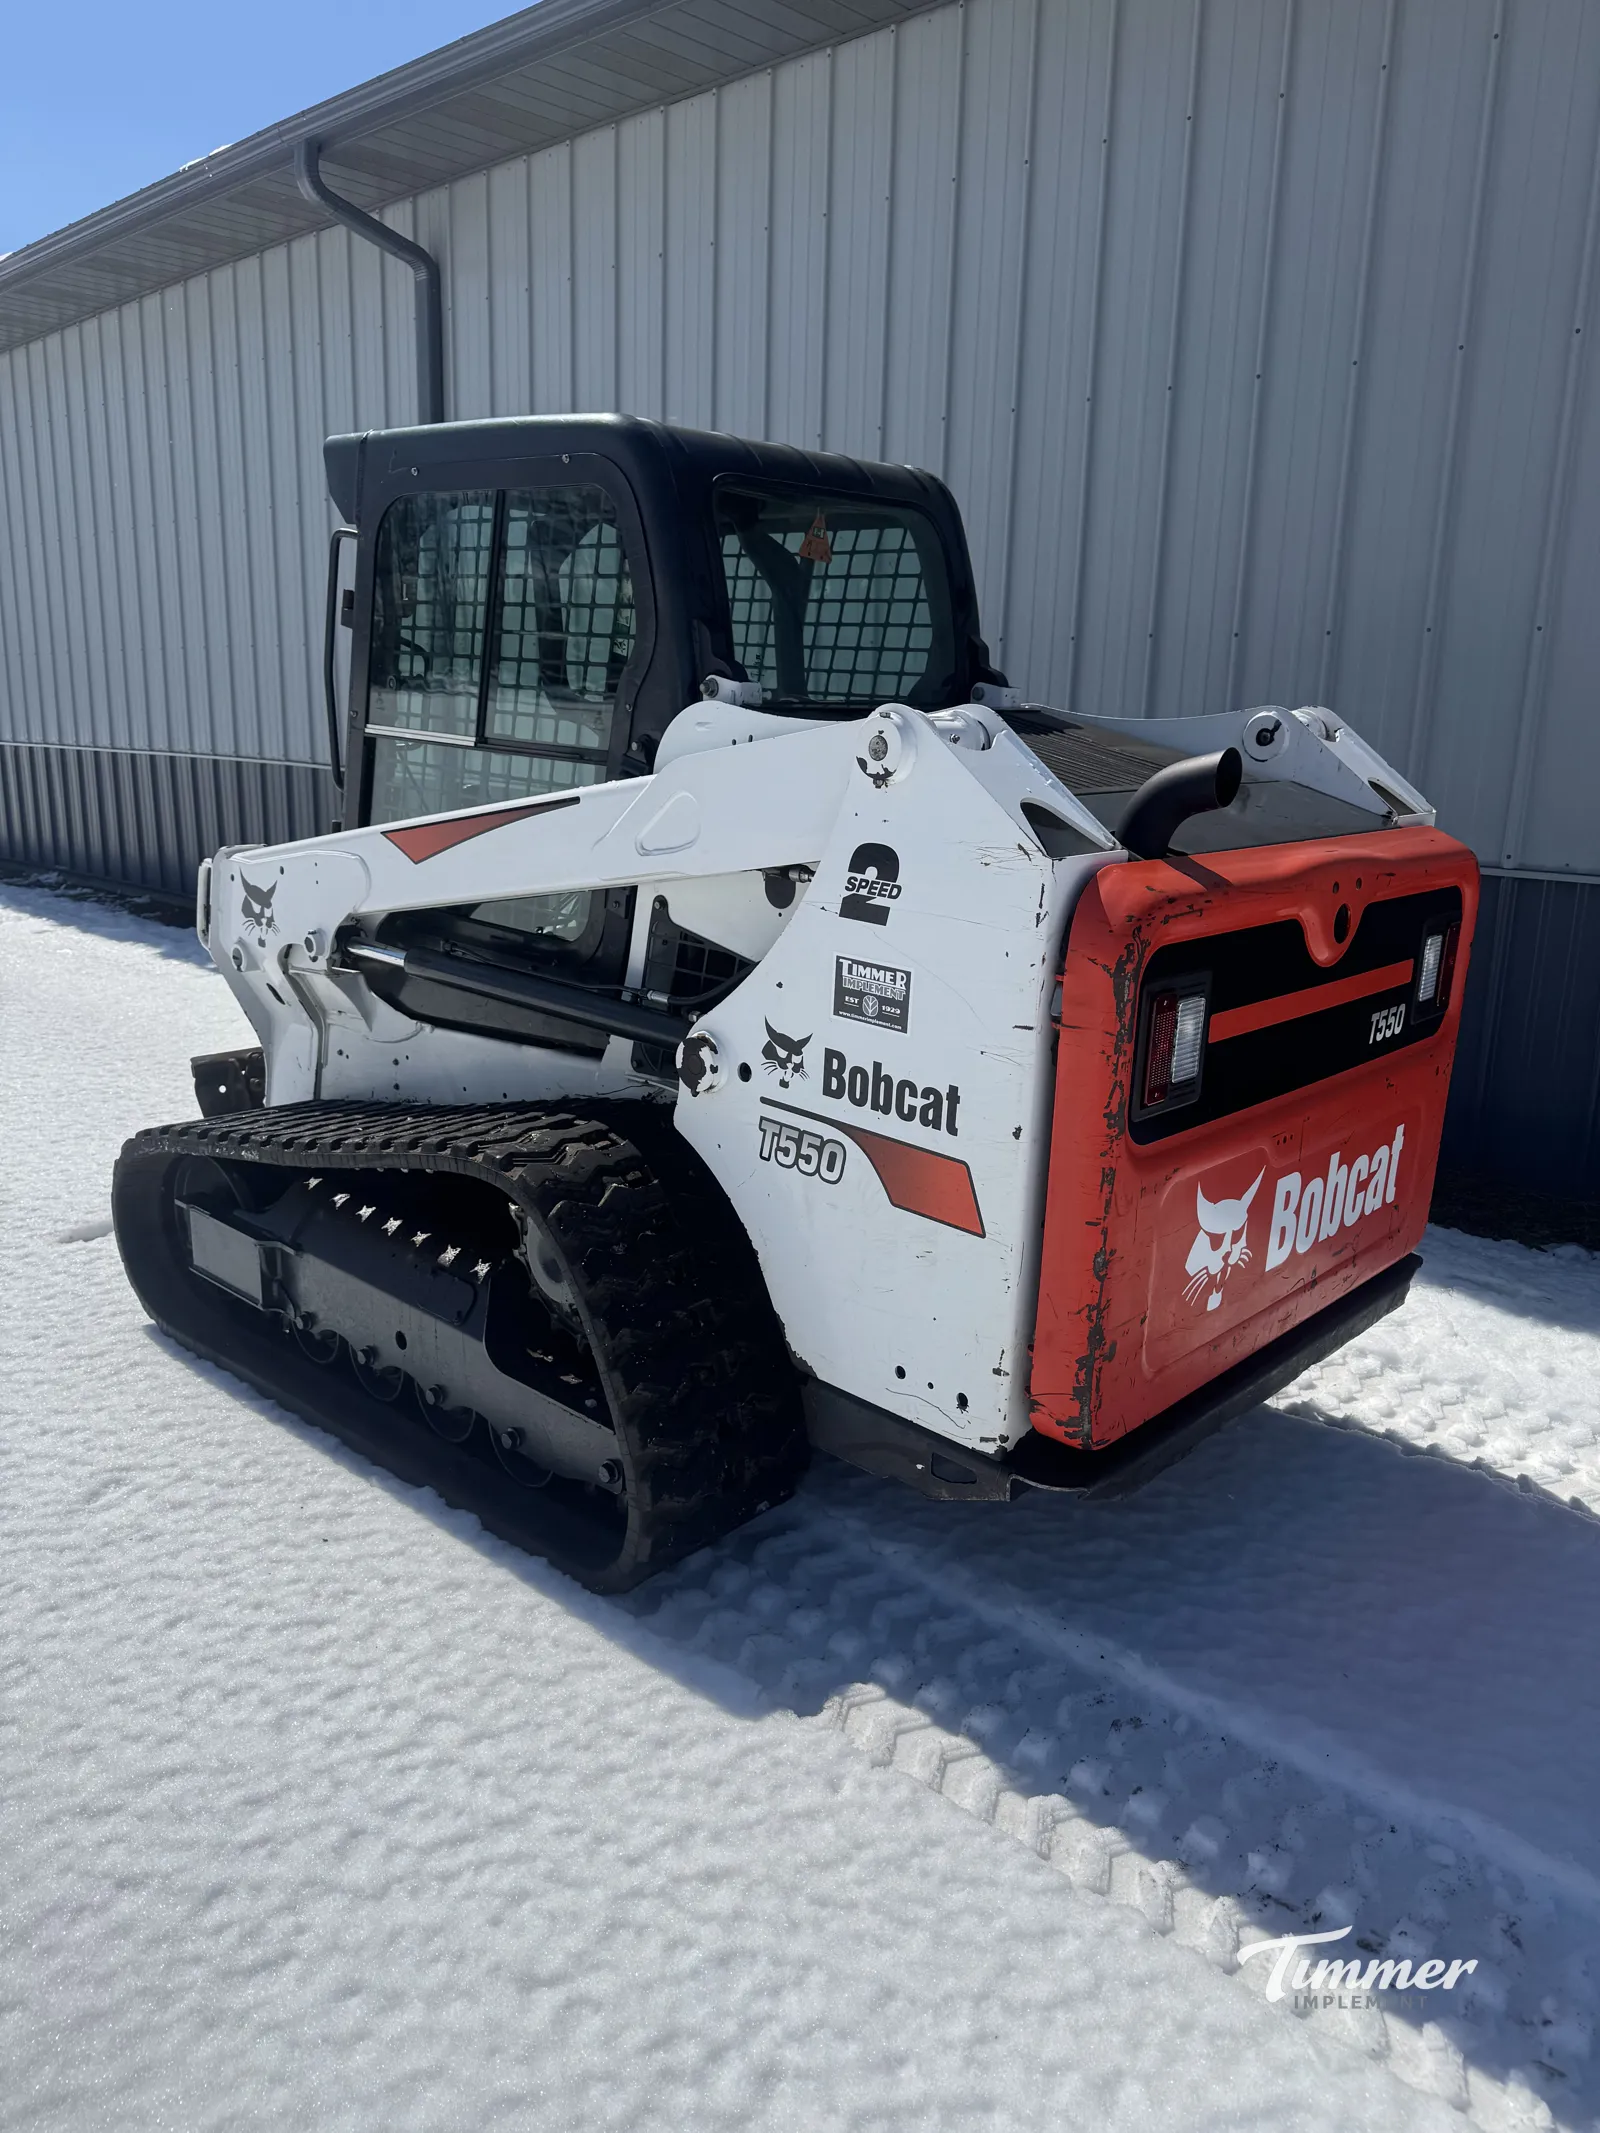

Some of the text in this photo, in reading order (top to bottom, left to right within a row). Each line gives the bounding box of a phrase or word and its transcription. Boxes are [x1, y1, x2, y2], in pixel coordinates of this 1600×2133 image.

[839, 842, 900, 926] 2
[844, 876, 903, 900] SPEED
[839, 958, 907, 990] TIMMER
[842, 976, 906, 1001] IMPLEMENT
[844, 995, 860, 1004] EST
[1368, 1003, 1406, 1045] T550
[822, 1047, 961, 1137] Bobcat
[758, 1115, 847, 1185] T550
[1265, 1123, 1405, 1272] Bobcat
